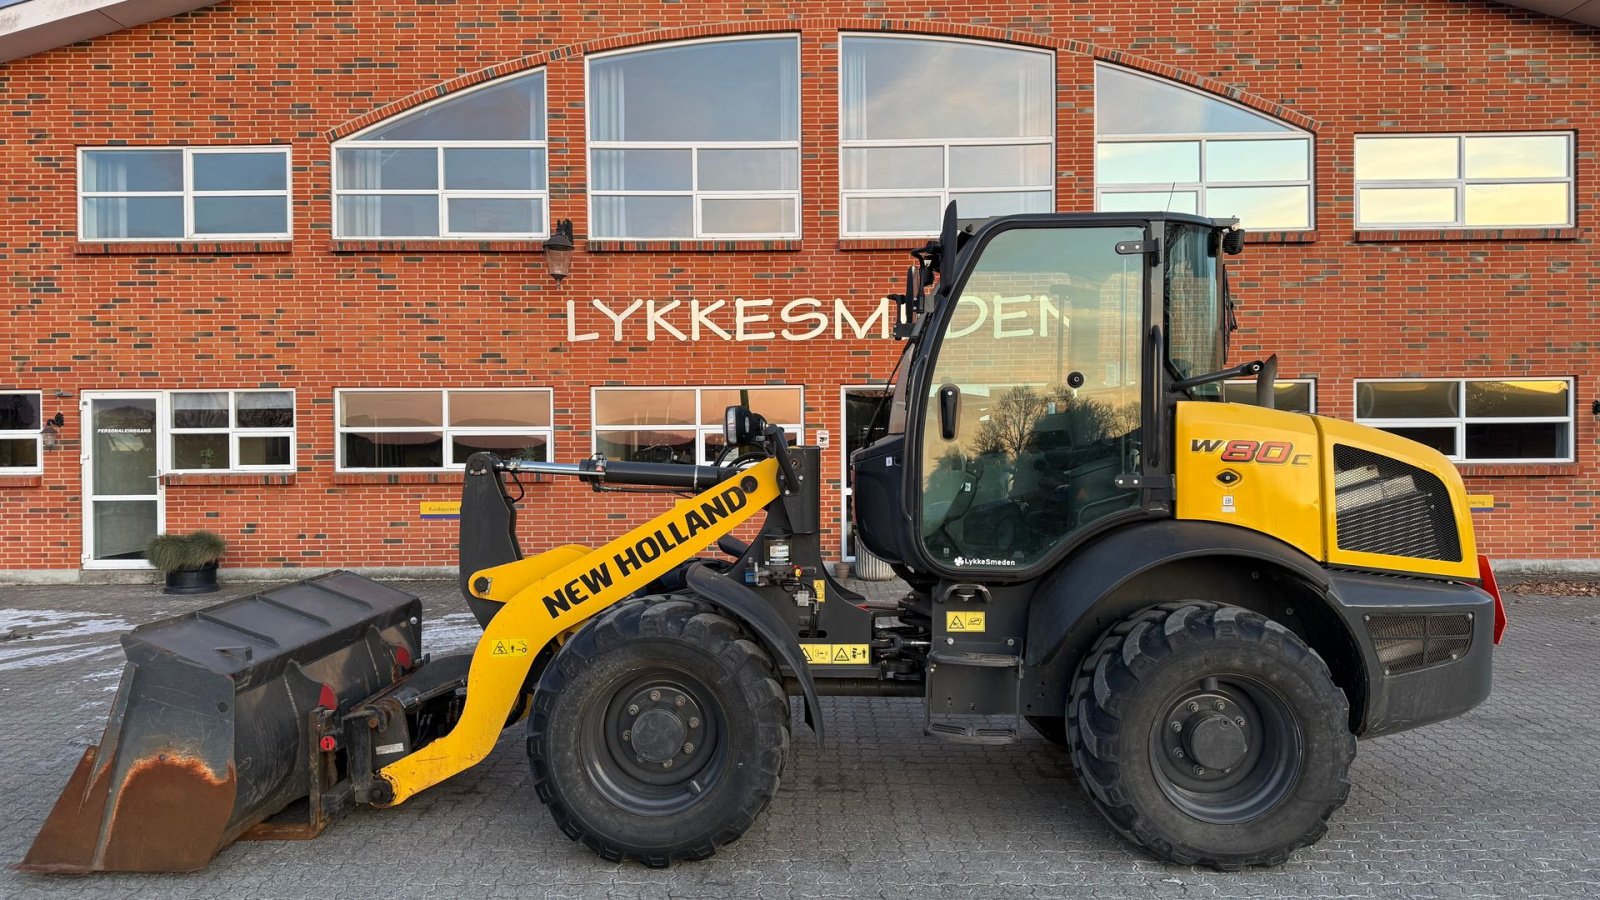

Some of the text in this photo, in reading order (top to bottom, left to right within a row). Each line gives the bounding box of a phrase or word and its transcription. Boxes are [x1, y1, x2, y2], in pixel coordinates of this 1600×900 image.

[567, 297, 1070, 342] LYKKESMDEN
[541, 485, 747, 619] NEW HOLLAND
[964, 558, 1016, 566] LykkeSmeden
